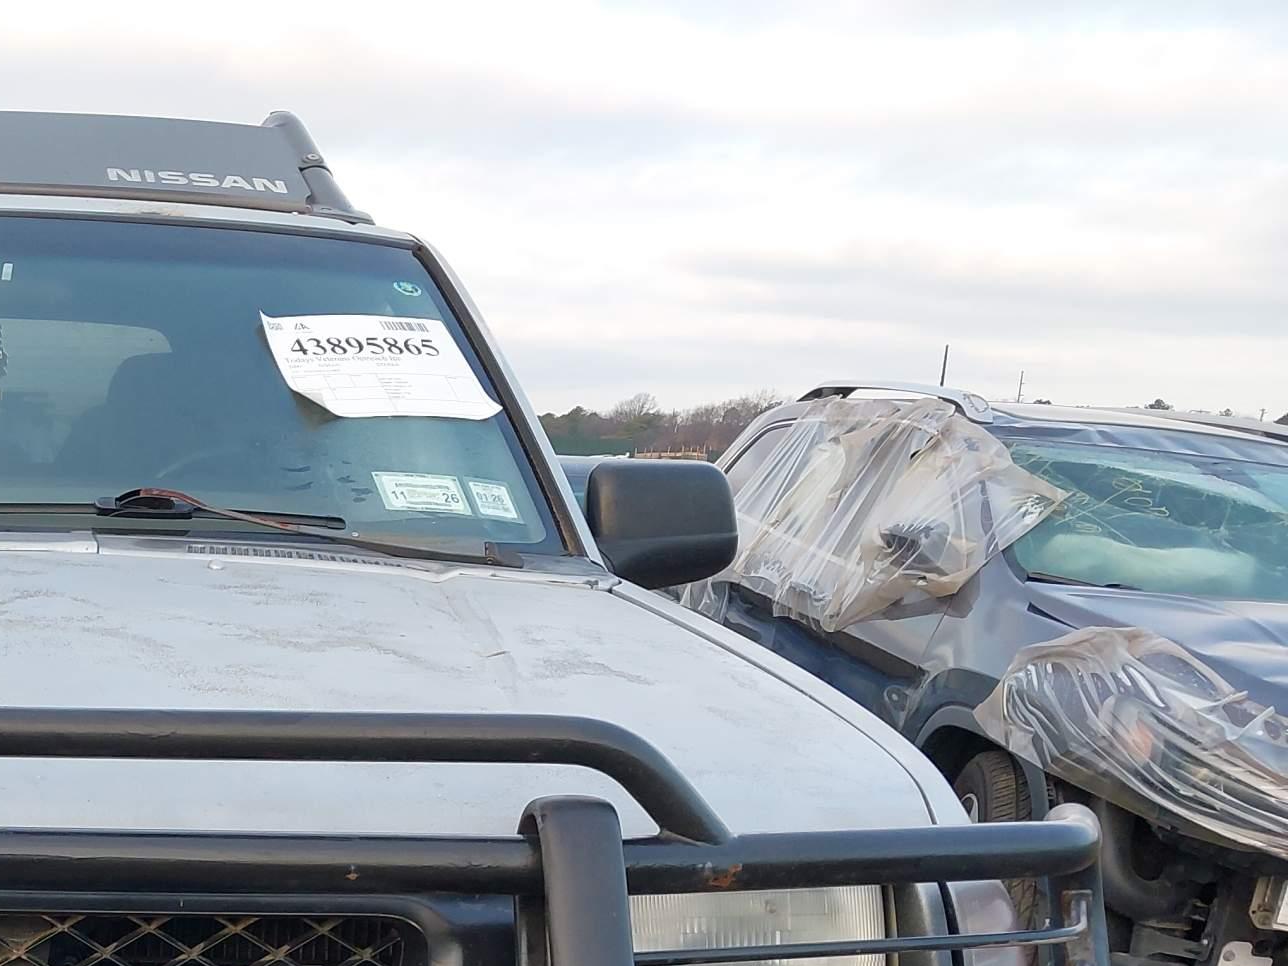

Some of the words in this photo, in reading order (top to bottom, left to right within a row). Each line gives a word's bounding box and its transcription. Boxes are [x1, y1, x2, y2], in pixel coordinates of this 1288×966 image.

[106, 167, 288, 194] NISSAN
[290, 336, 440, 357] 43895865
[392, 490, 408, 501] 11
[442, 492, 460, 504] 26
